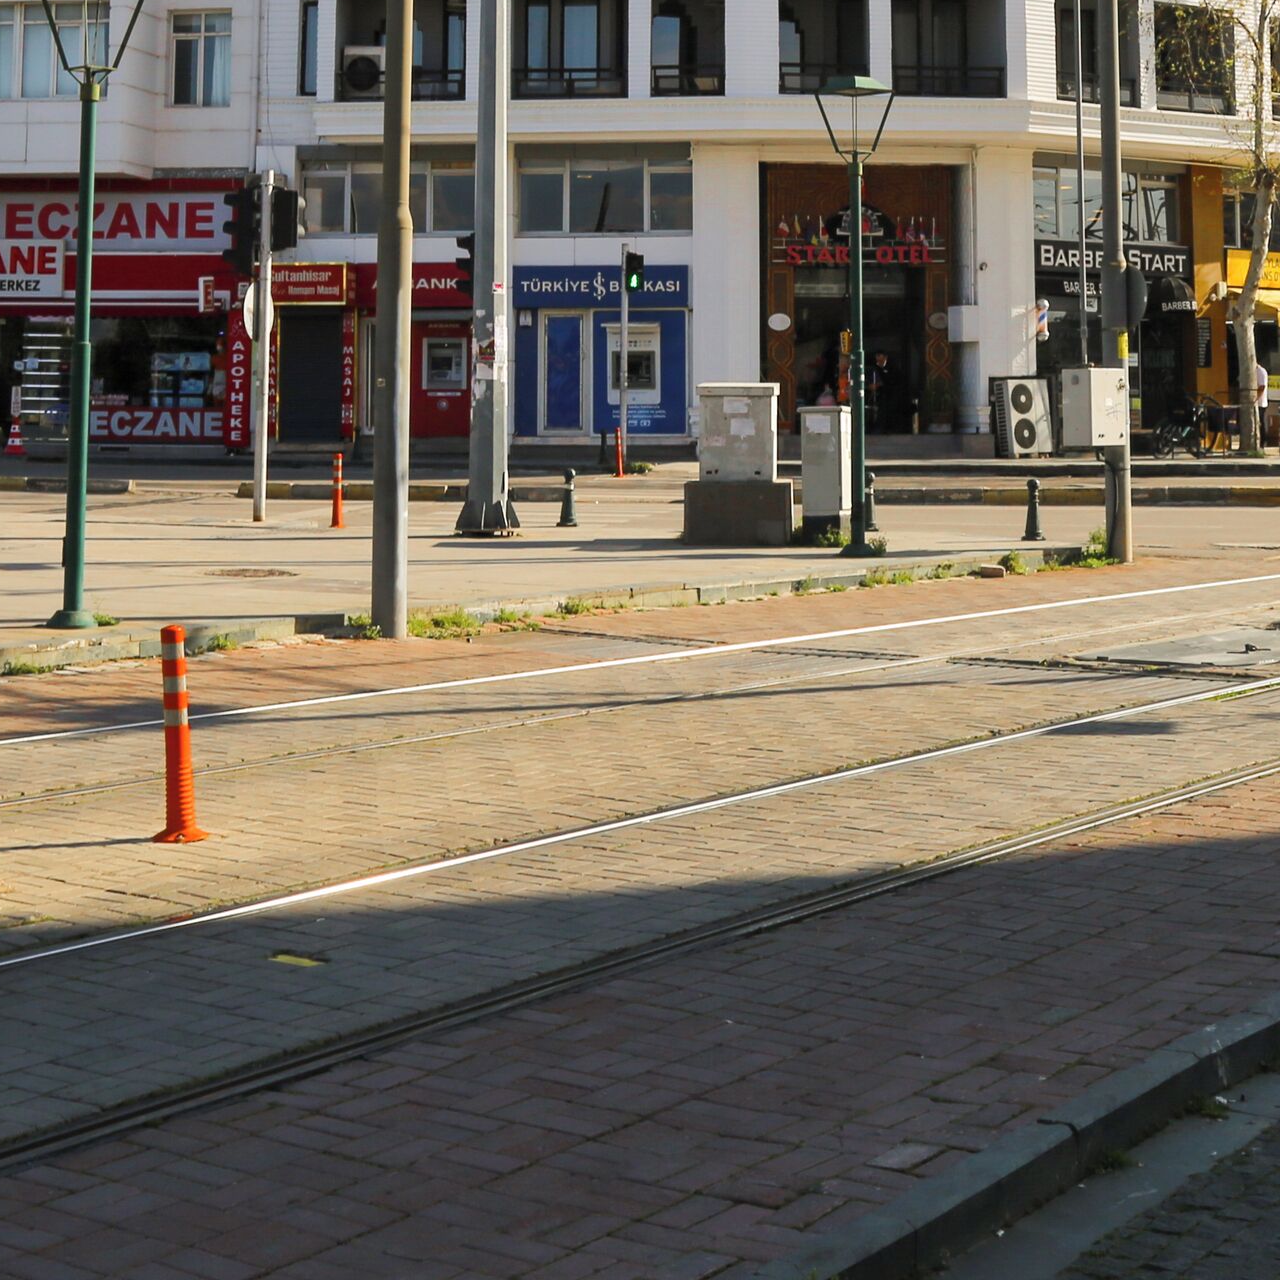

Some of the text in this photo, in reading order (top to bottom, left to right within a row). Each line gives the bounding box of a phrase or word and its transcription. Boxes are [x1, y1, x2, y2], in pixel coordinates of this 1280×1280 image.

[785, 245, 932, 265] STAR OTEL
[1040, 244, 1186, 273] BARBE START
[372, 278, 459, 289] AANK
[521, 278, 680, 293] TÜRKİYE BKASI
[1064, 281, 1097, 295] BARER
[1162, 300, 1190, 312] BARBER
[343, 346, 354, 397] MASAJ
[230, 340, 245, 441] APOTHEKE
[90, 410, 223, 437] ECZANE
